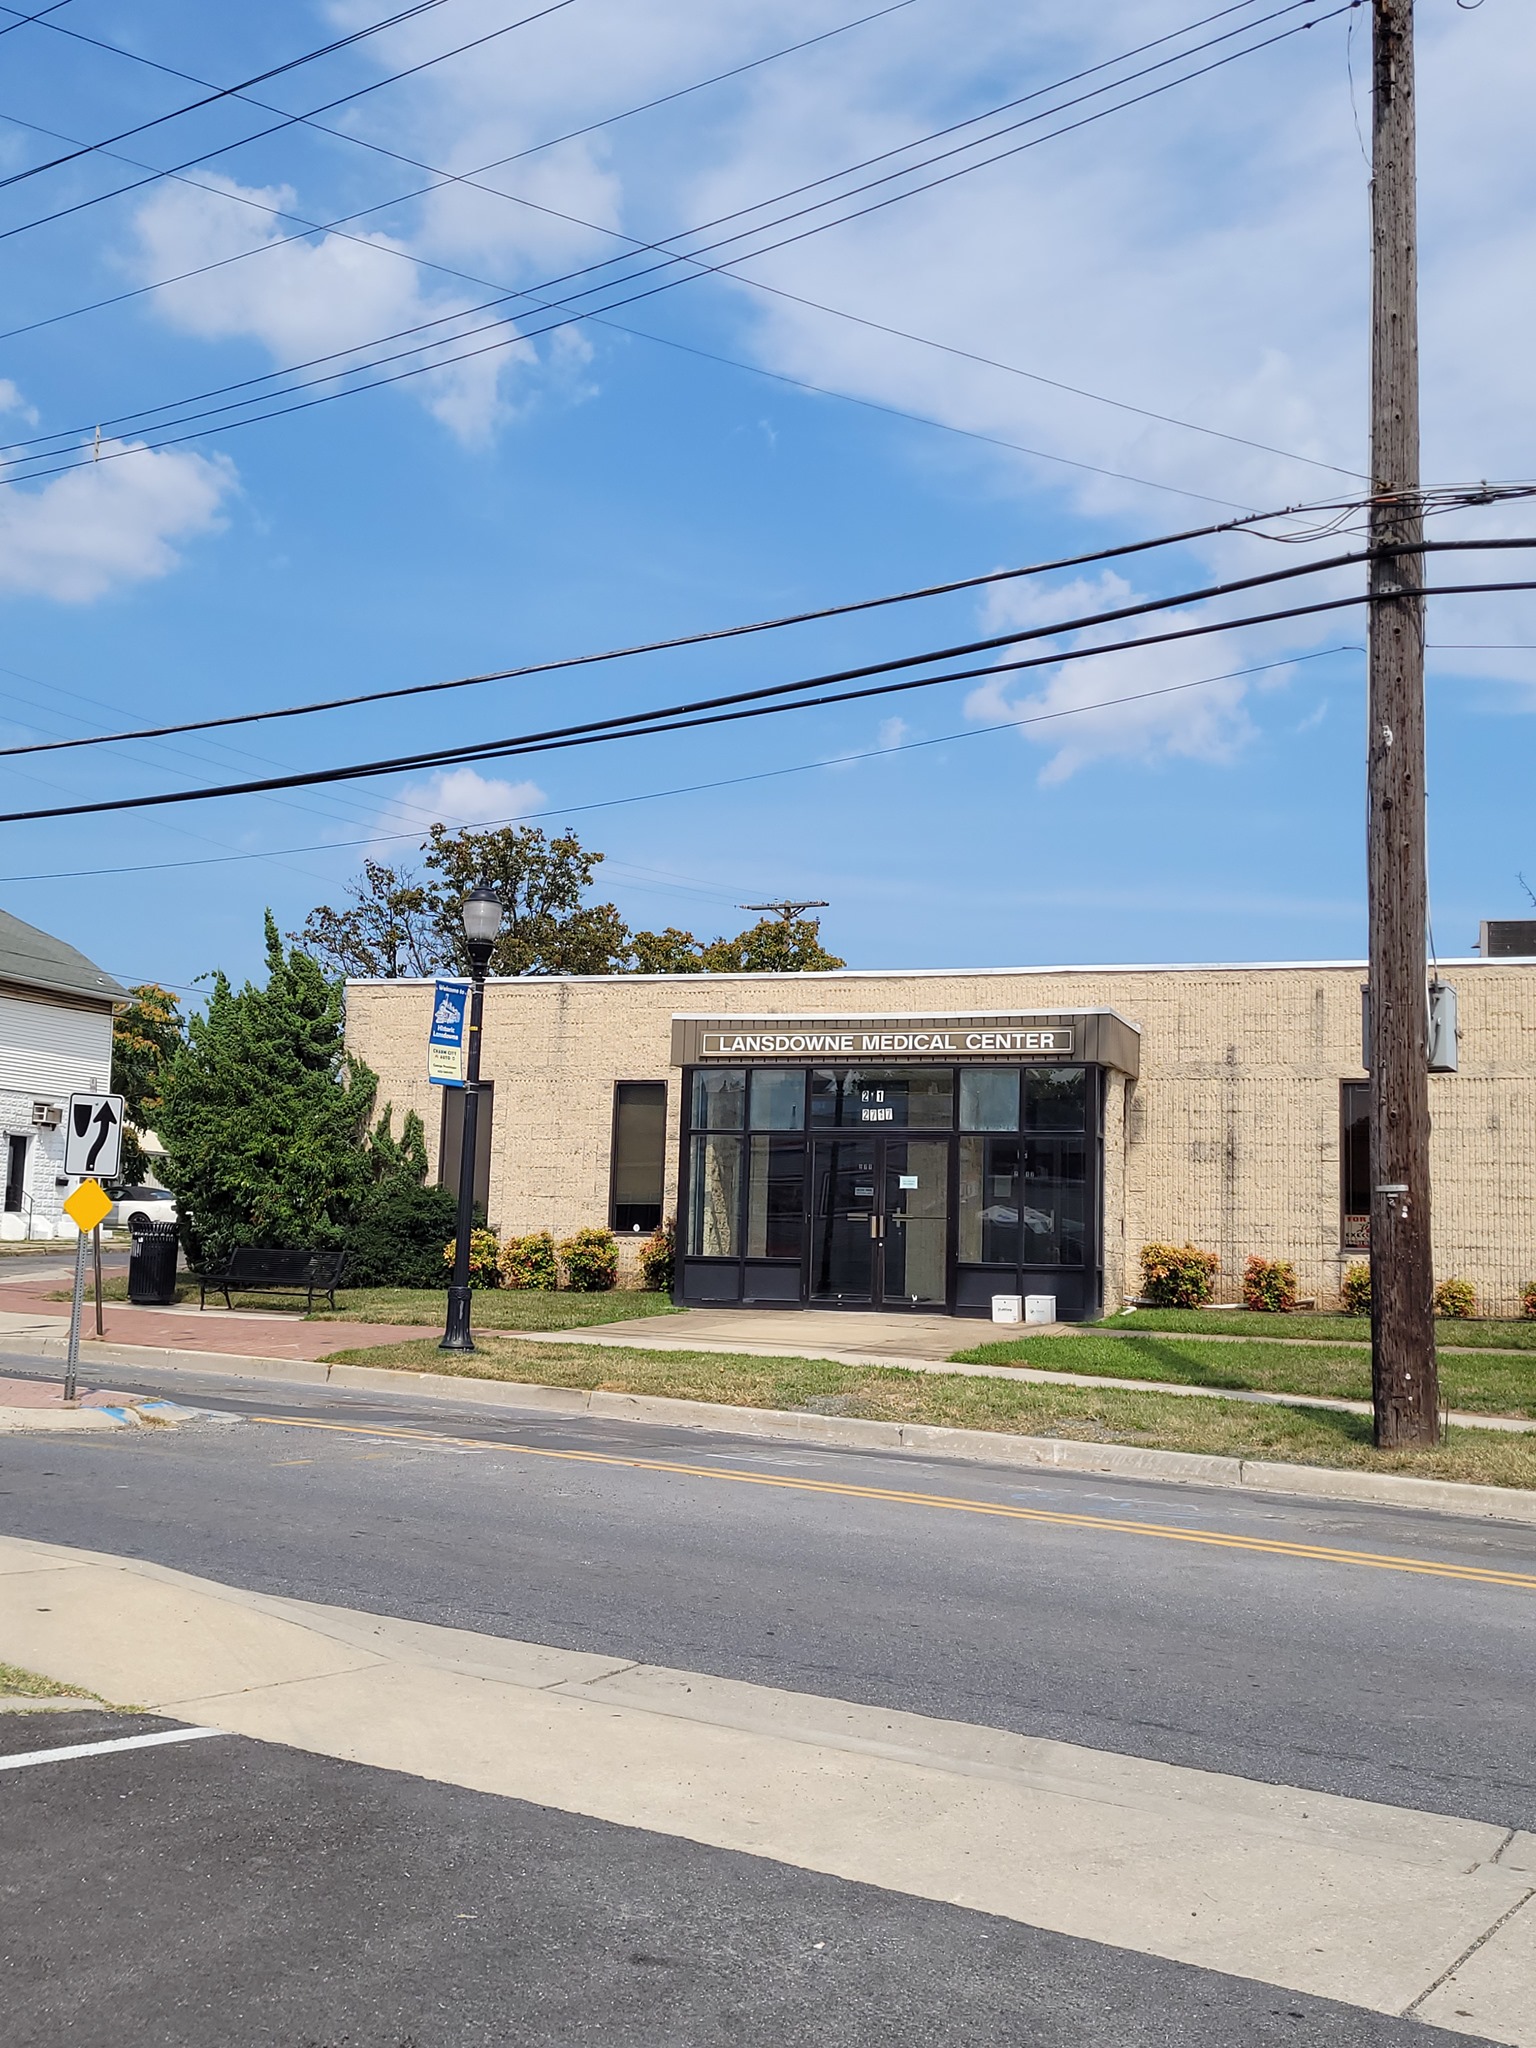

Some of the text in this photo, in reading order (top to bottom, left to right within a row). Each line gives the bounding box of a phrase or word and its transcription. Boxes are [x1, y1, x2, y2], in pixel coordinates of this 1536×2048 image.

[719, 1033, 1055, 1051] LANSDOWNE MEDICAL CENTER
